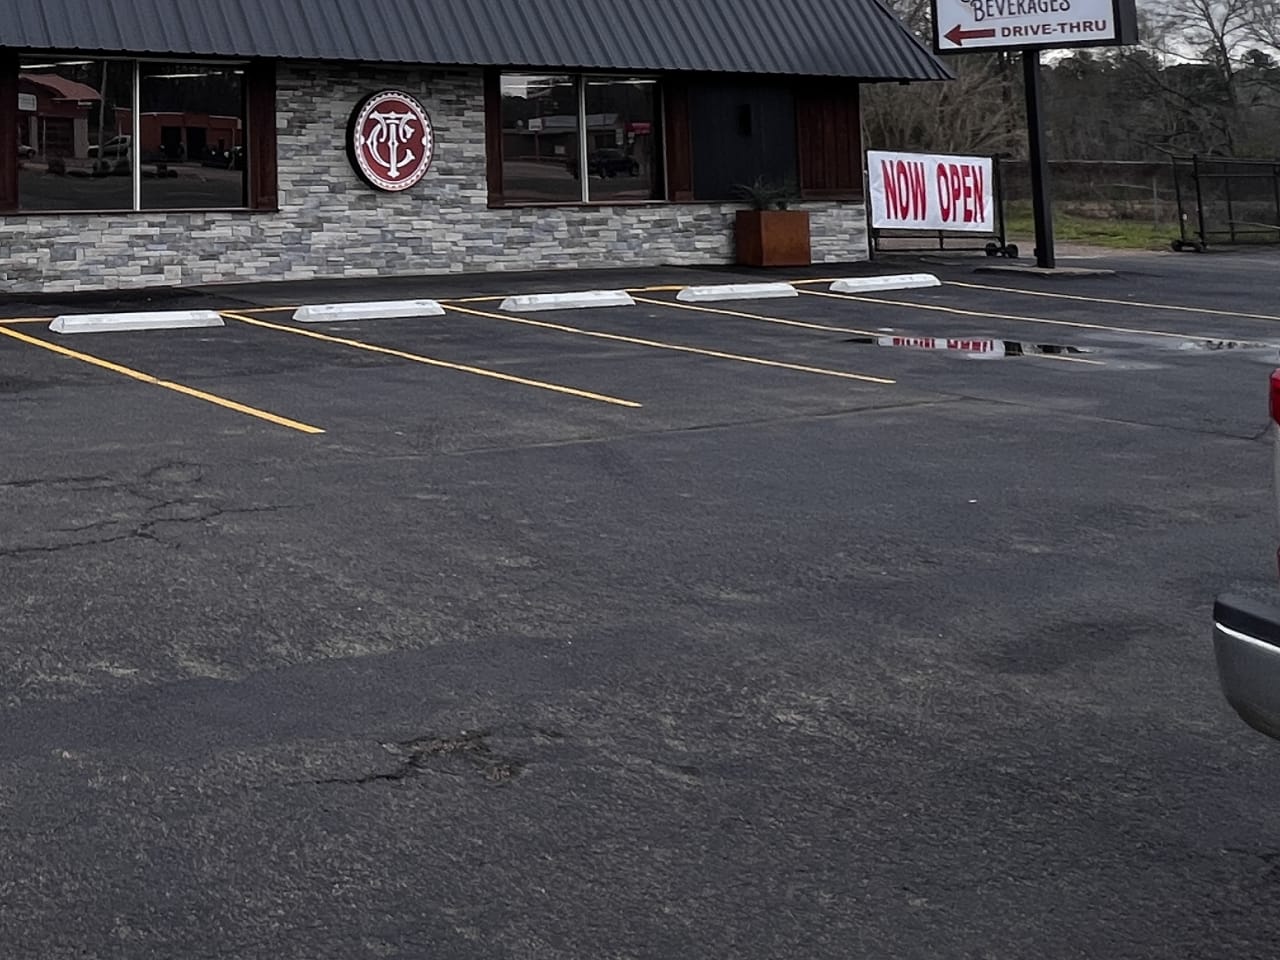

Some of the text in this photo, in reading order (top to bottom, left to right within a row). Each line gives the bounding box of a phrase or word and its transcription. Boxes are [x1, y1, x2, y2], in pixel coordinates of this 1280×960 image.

[1001, 20, 1107, 37] DRIVE-THRU
[881, 159, 985, 223] NOW OPEN
